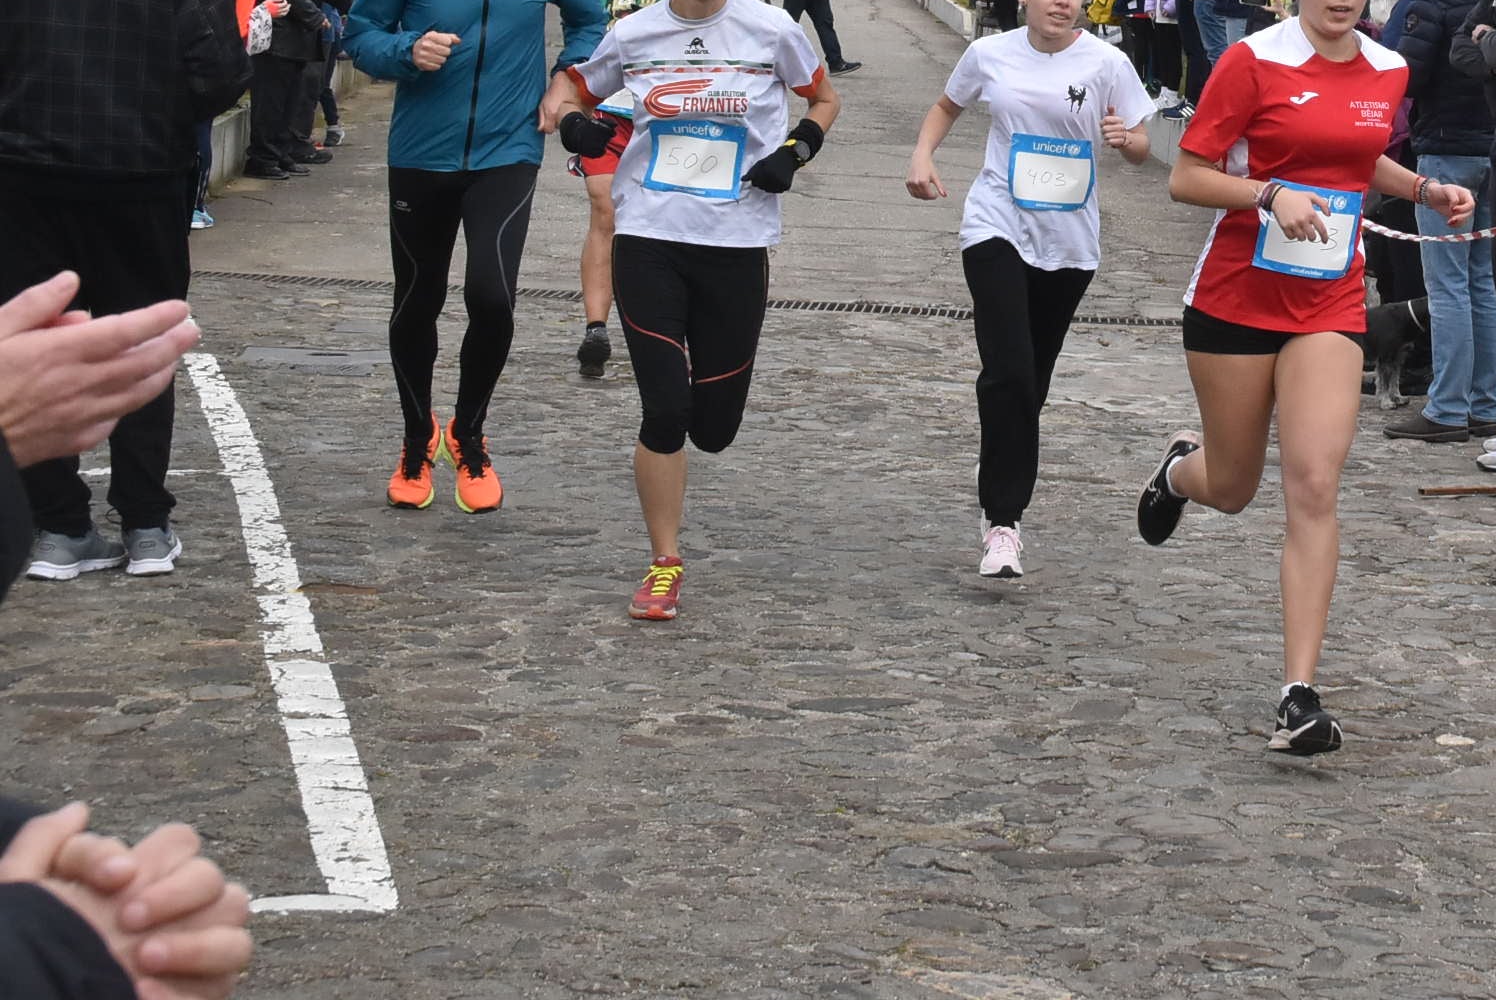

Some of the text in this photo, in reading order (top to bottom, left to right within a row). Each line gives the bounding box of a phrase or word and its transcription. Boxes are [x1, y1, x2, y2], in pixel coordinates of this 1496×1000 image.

[1350, 101, 1389, 109] ATLETISMO
[672, 123, 709, 136] unicef
[1032, 141, 1069, 155] unicef
[665, 146, 719, 174] 500
[1025, 168, 1066, 187] 403
